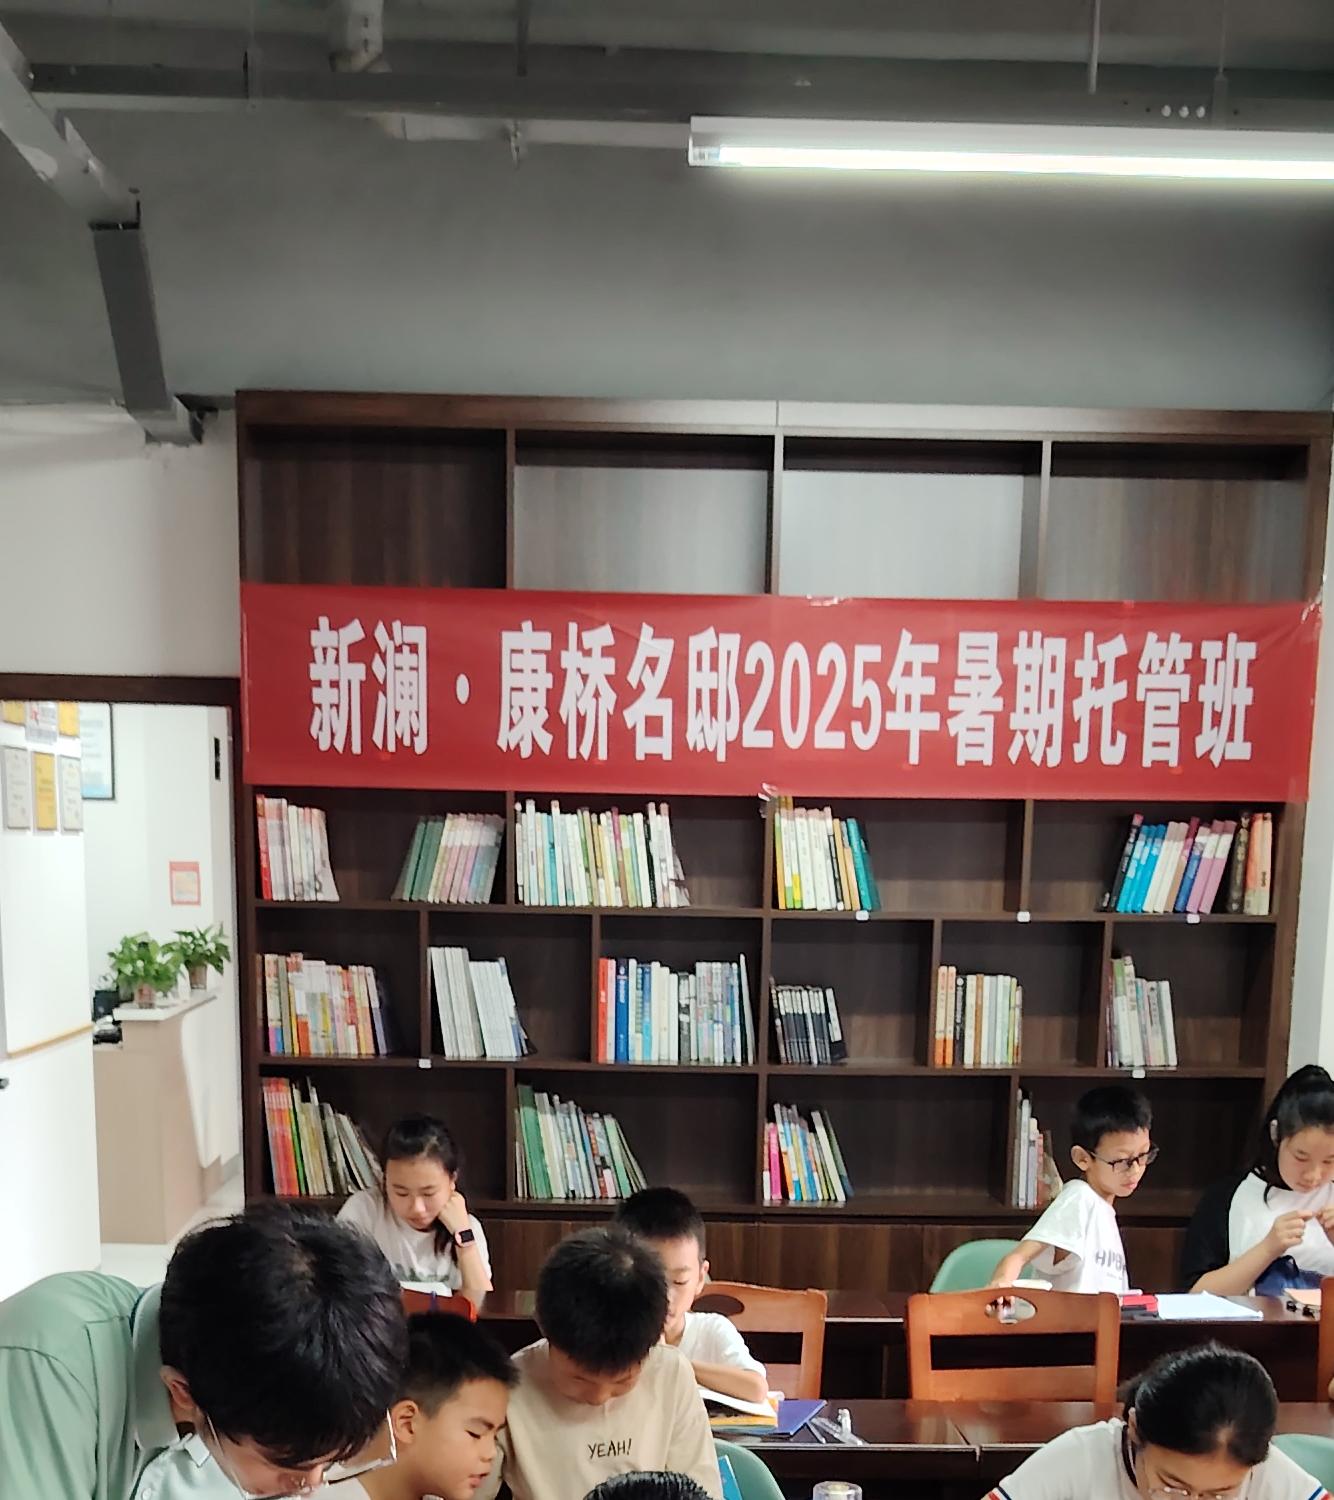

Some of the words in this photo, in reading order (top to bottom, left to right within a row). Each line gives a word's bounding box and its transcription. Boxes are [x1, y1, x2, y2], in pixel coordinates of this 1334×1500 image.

[309, 616, 1257, 769] 新澜·康桥名邸2025年暑期托管班
[587, 1438, 633, 1459] YEAH!
